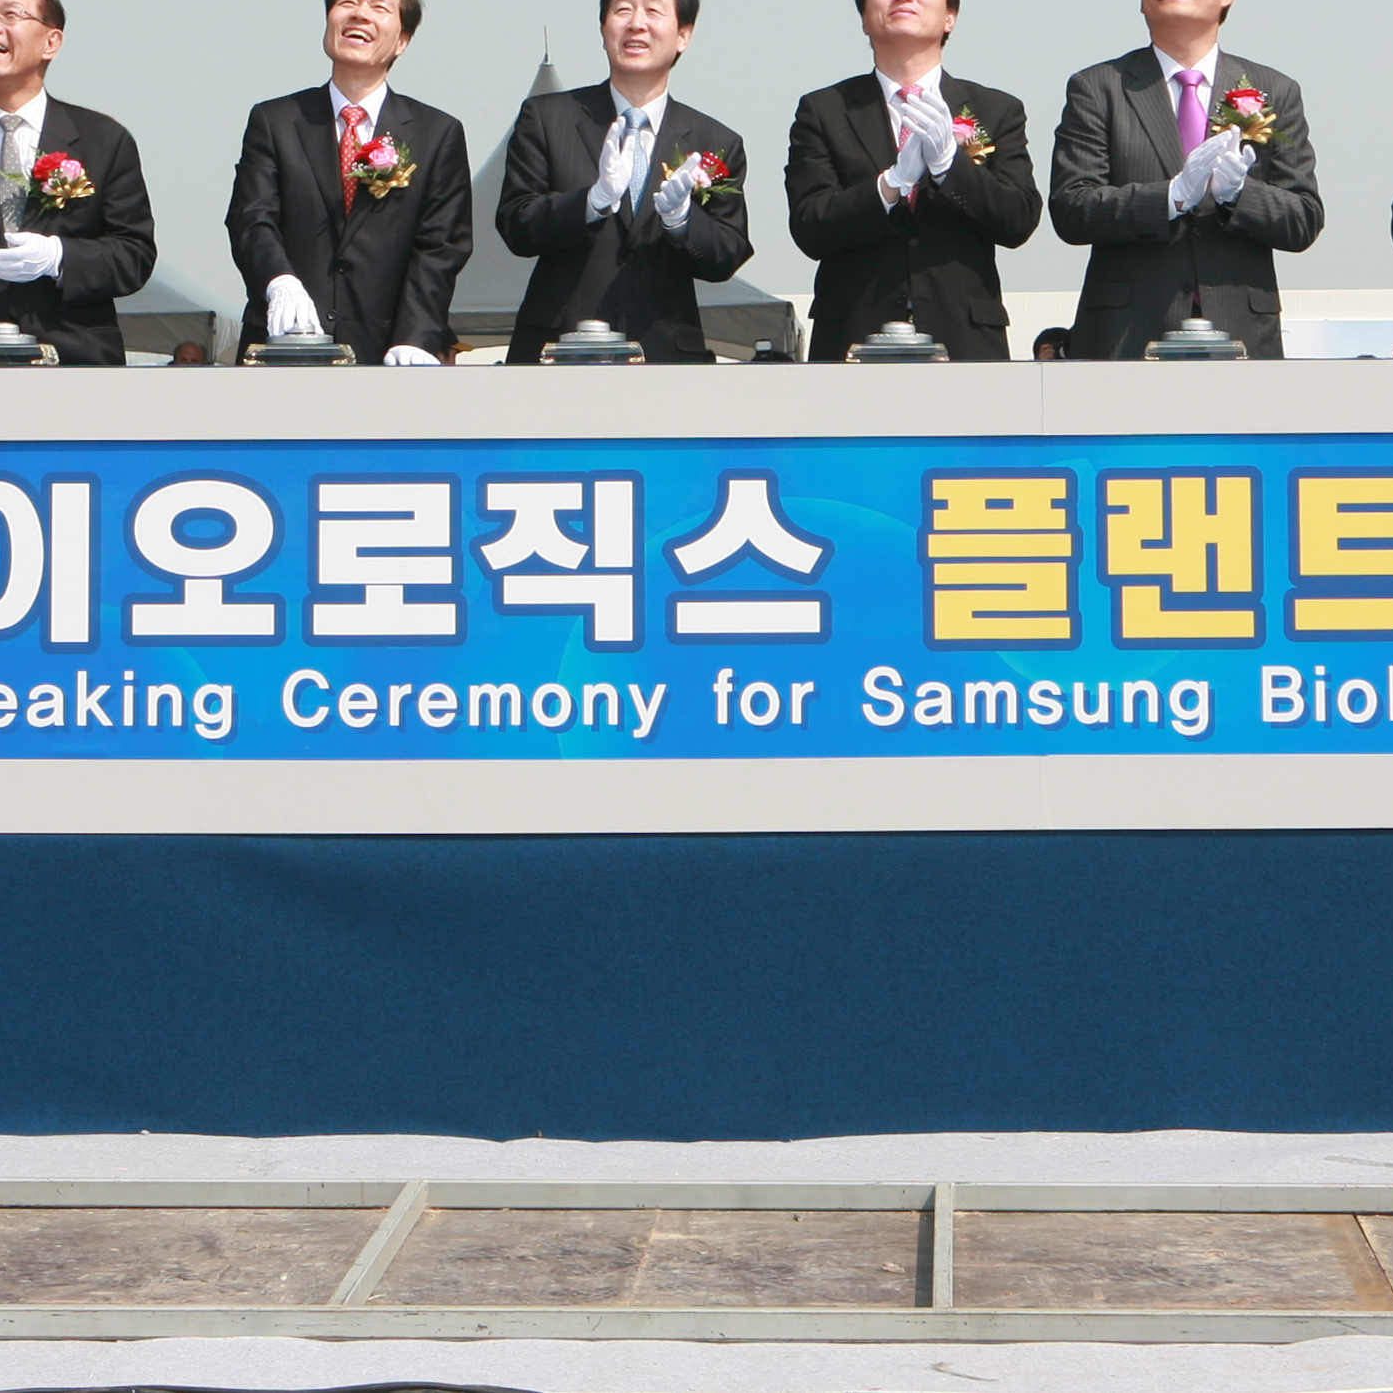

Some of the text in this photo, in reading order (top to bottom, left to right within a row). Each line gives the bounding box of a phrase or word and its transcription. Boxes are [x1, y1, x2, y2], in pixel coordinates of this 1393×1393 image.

[282, 669, 667, 739] Ceremony
[713, 668, 814, 726] for
[862, 666, 1209, 736] Samsung
